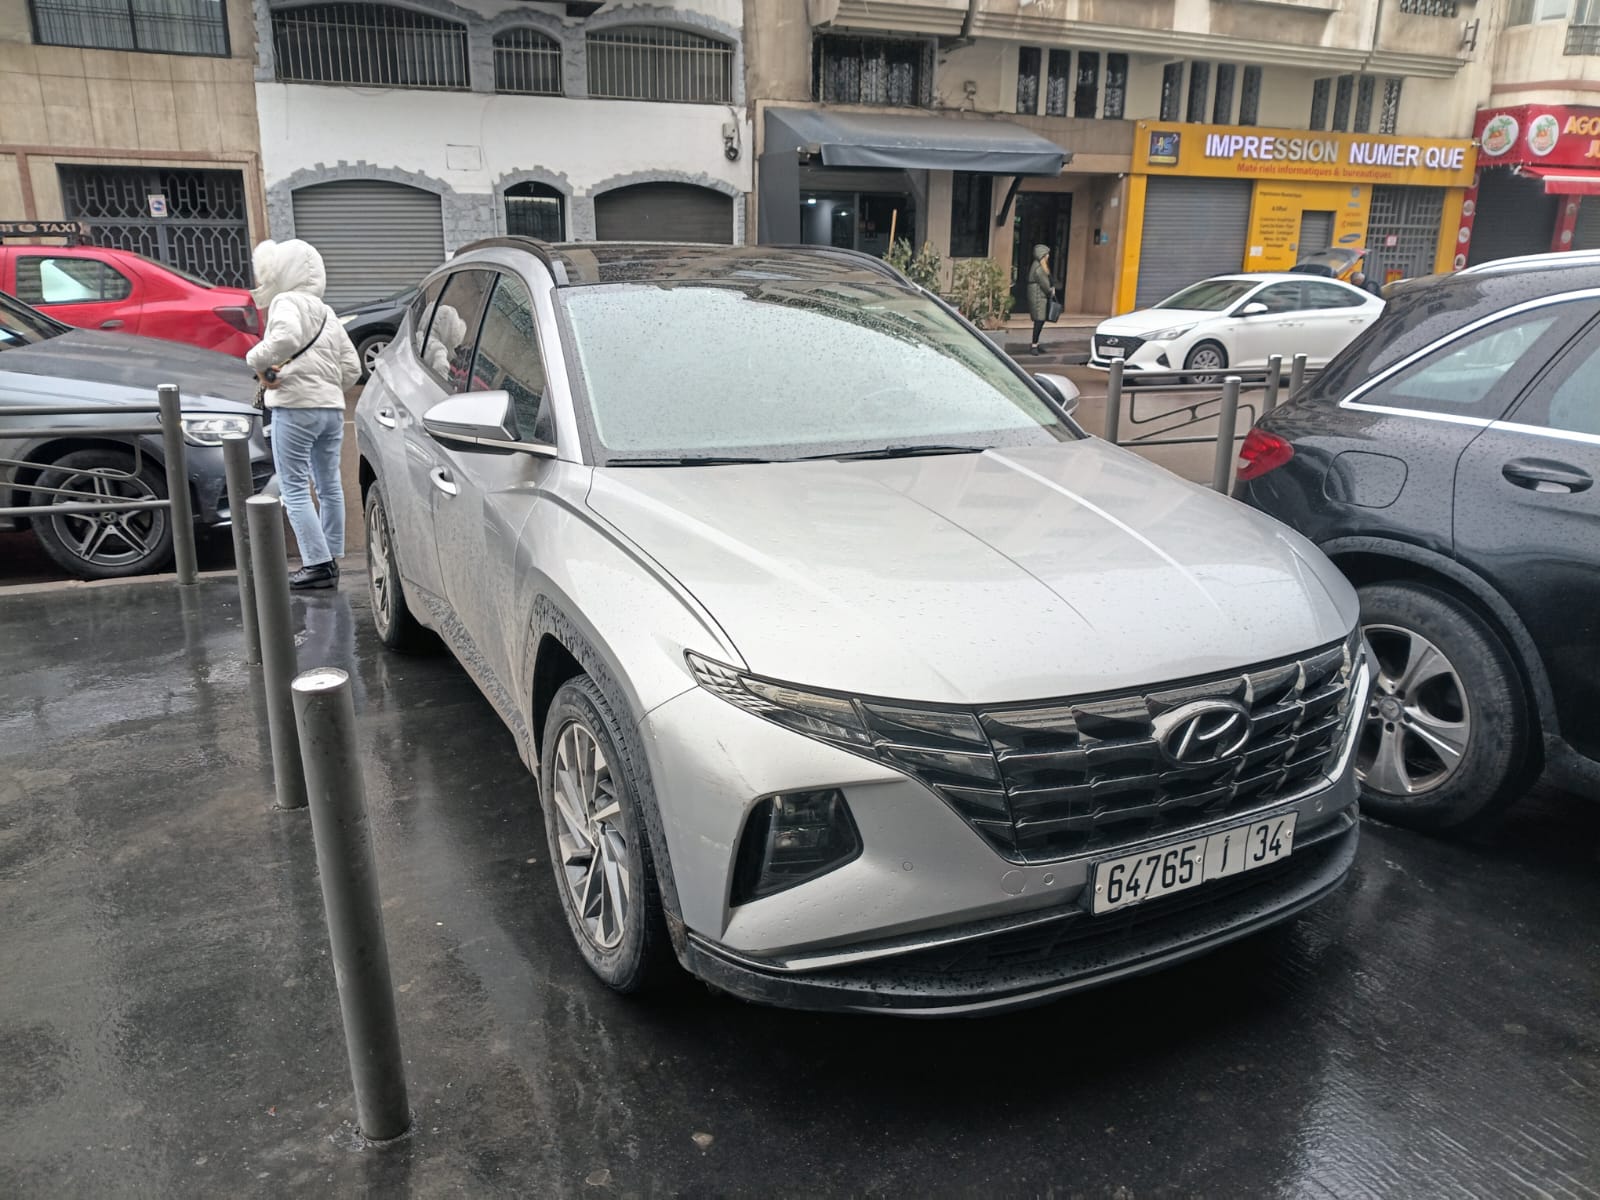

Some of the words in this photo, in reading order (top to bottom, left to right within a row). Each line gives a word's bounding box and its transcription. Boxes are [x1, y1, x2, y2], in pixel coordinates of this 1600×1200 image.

[1205, 133, 1339, 163] IMPRESSION
[1277, 165, 1332, 177] informatiques
[40, 223, 76, 233] TAXI
[1107, 845, 1196, 904] 64765
[1253, 820, 1285, 862] 34
